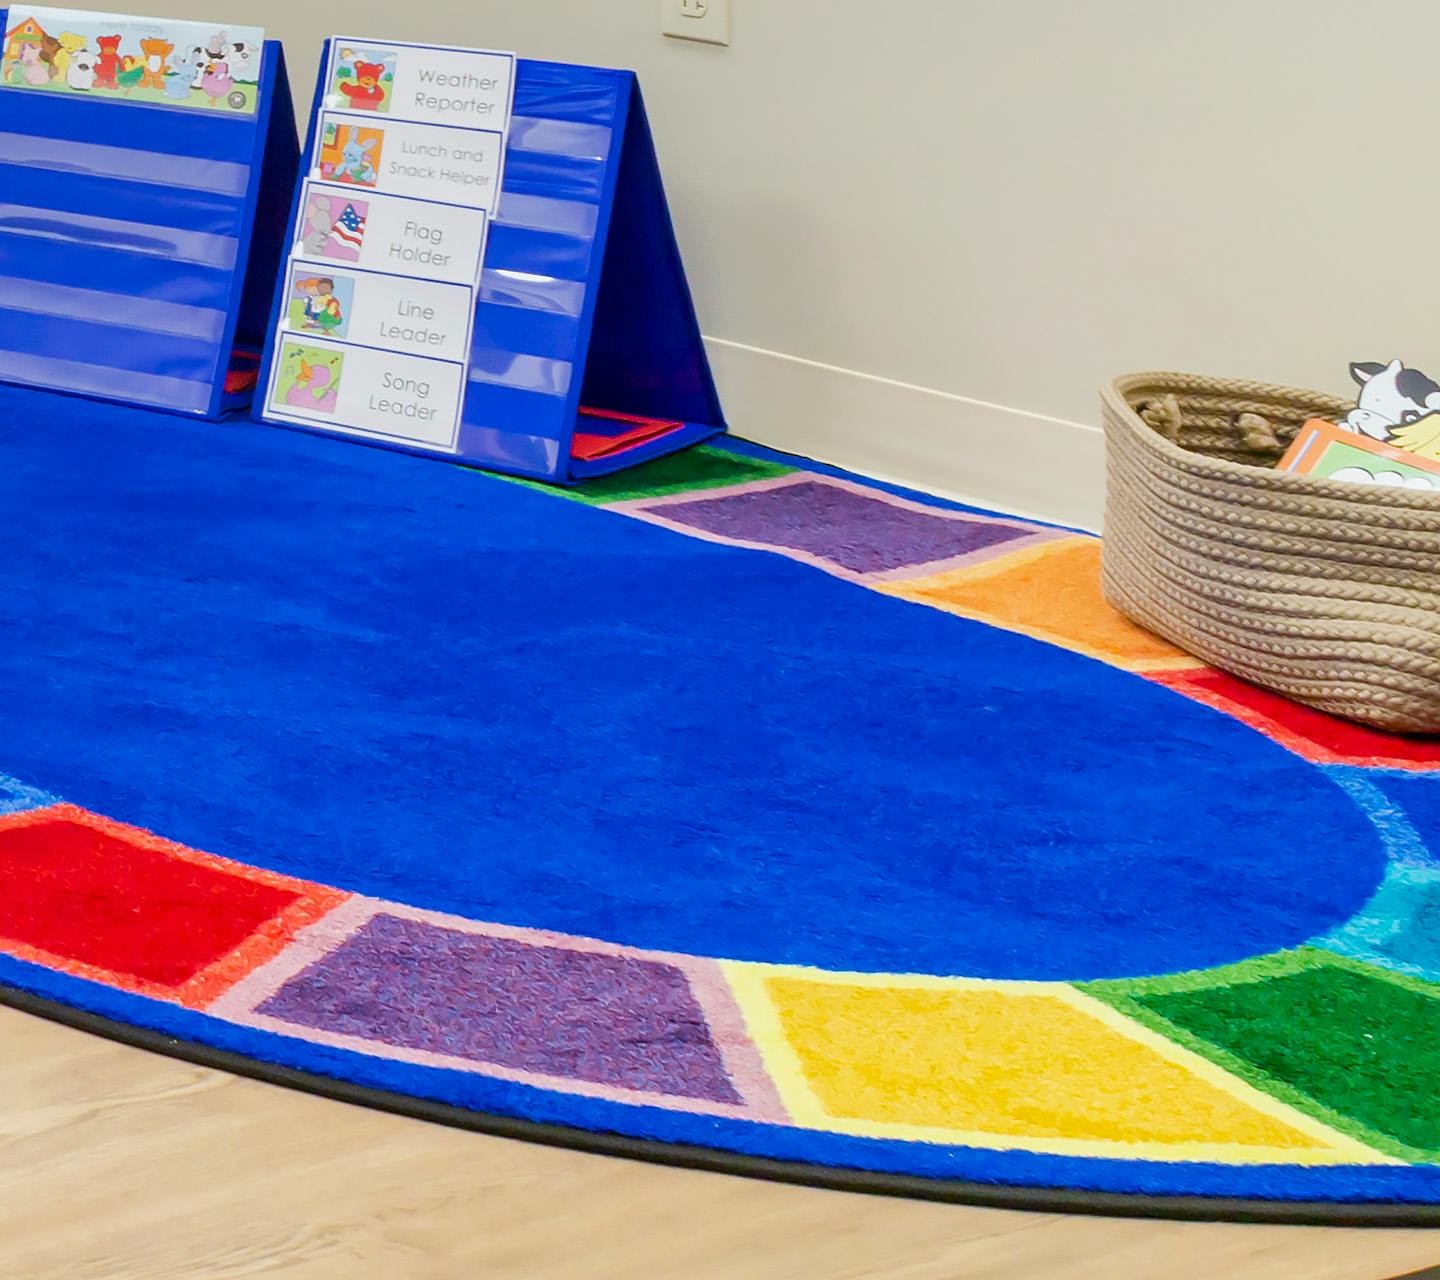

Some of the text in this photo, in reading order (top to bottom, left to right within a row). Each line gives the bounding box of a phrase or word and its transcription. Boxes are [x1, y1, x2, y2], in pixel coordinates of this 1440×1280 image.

[419, 68, 499, 91] Weather
[414, 92, 496, 115] Reporter
[401, 140, 484, 163] Lunch and
[389, 161, 491, 187] Snack Helper
[404, 220, 443, 246] Flag
[388, 243, 452, 267] Holder
[397, 300, 435, 321] Line
[379, 321, 447, 346] Leader
[382, 371, 430, 399] Song
[368, 393, 438, 421] Leader
